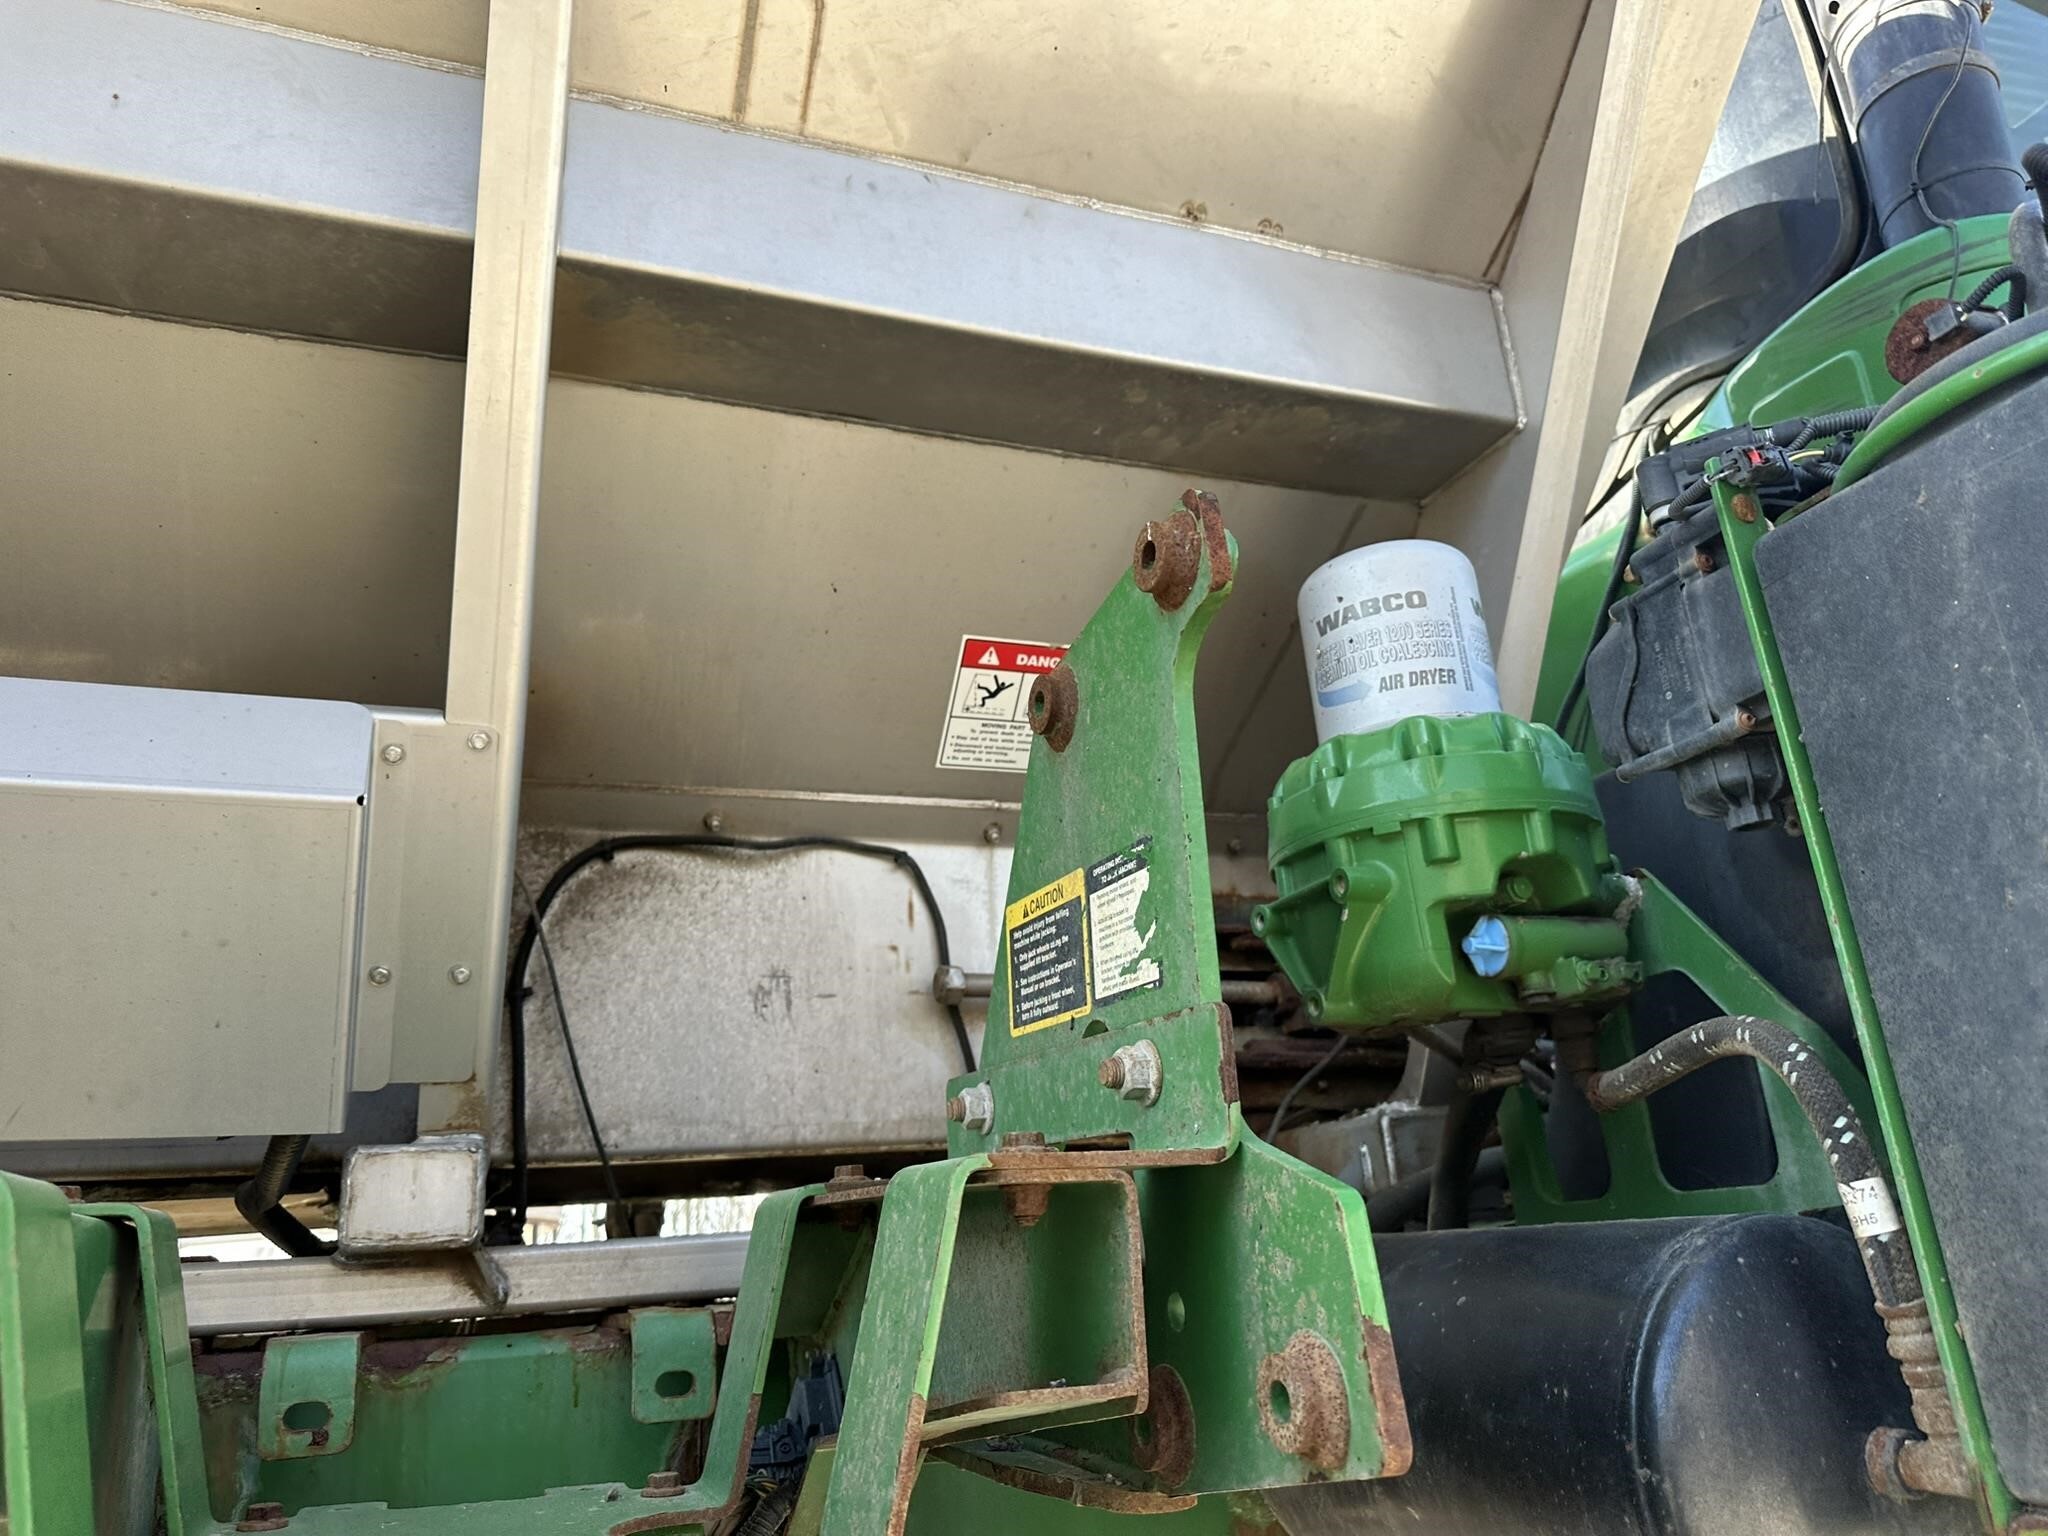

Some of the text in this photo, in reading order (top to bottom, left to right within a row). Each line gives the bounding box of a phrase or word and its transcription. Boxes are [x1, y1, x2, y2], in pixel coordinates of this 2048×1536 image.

[1316, 590, 1427, 637] WABCO
[1348, 628, 1381, 654] SAVER
[1385, 622, 1414, 643] 1200
[1415, 620, 1452, 639] SERIES
[1016, 653, 1061, 669] DANG
[1360, 649, 1378, 670] OIL
[1380, 639, 1456, 664] COALESCING
[1379, 667, 1457, 693] AIR DRYER
[1030, 882, 1064, 914] CAUTION
